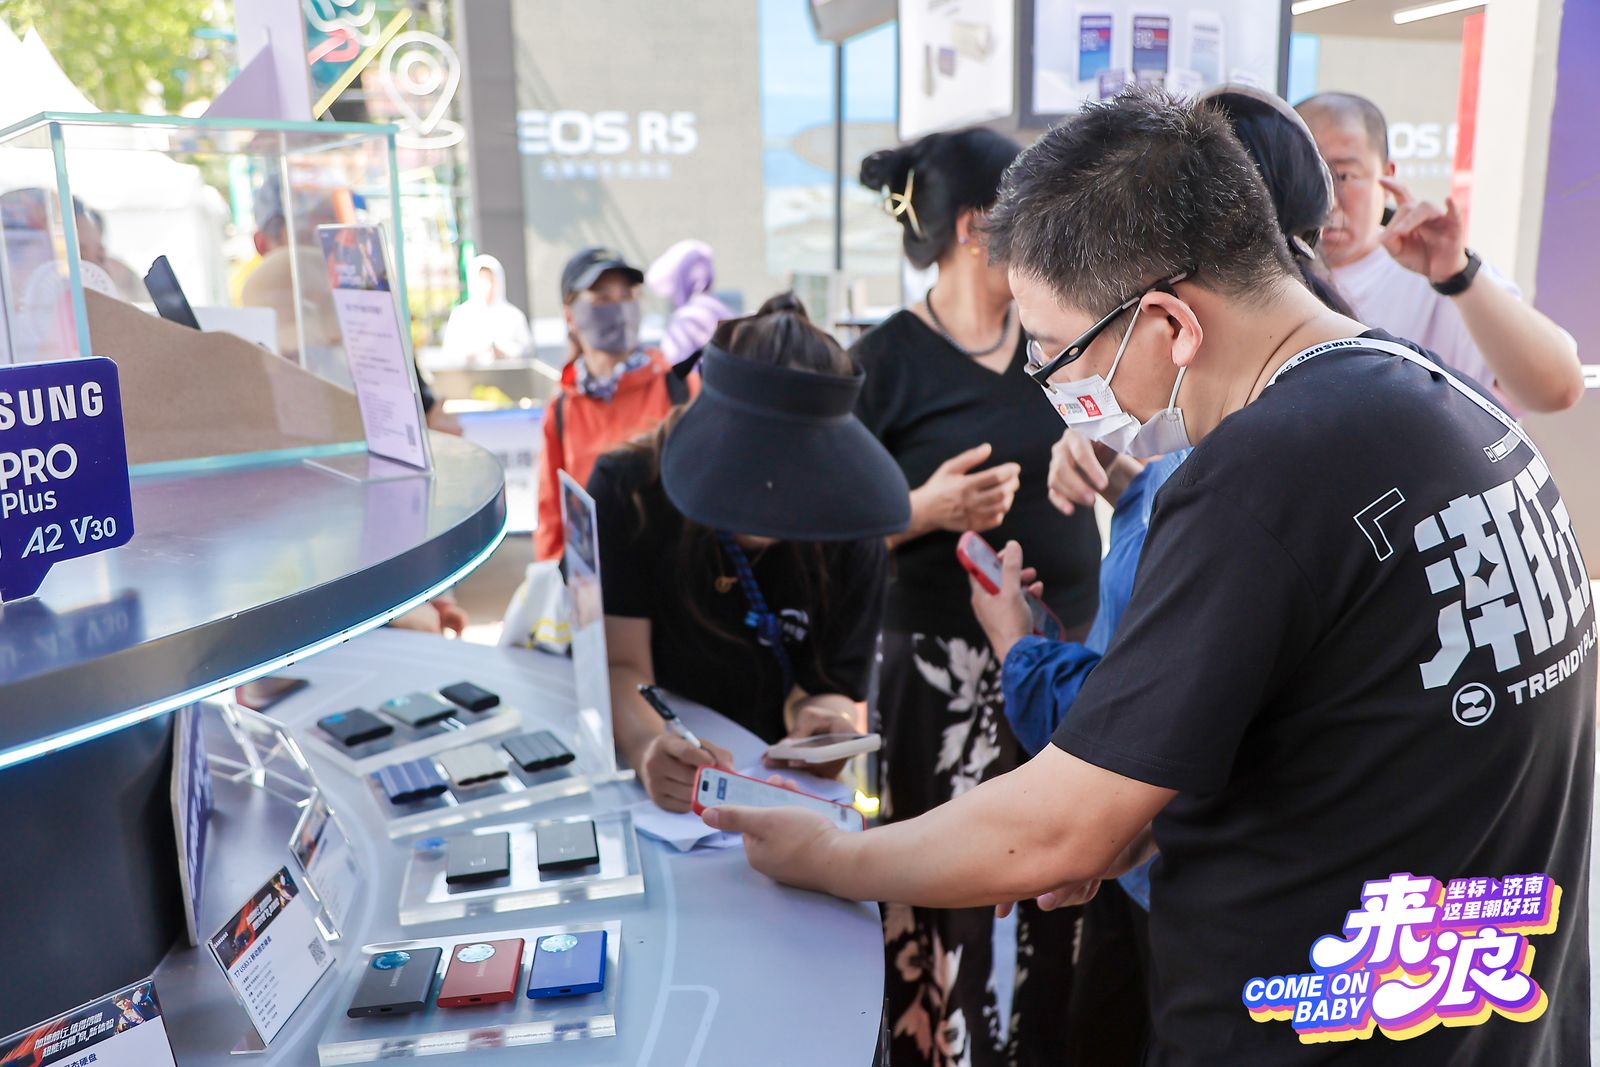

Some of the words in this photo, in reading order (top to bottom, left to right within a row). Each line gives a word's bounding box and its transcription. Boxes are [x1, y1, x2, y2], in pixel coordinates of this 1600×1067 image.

[516, 110, 630, 154] EOS
[638, 110, 697, 154] R5
[1297, 340, 1361, 362] SAMSUNG
[0, 381, 104, 430] SUNG
[0, 443, 78, 490] PRO
[3, 489, 58, 519] Plus
[21, 524, 65, 559] A2
[70, 515, 117, 544] V30
